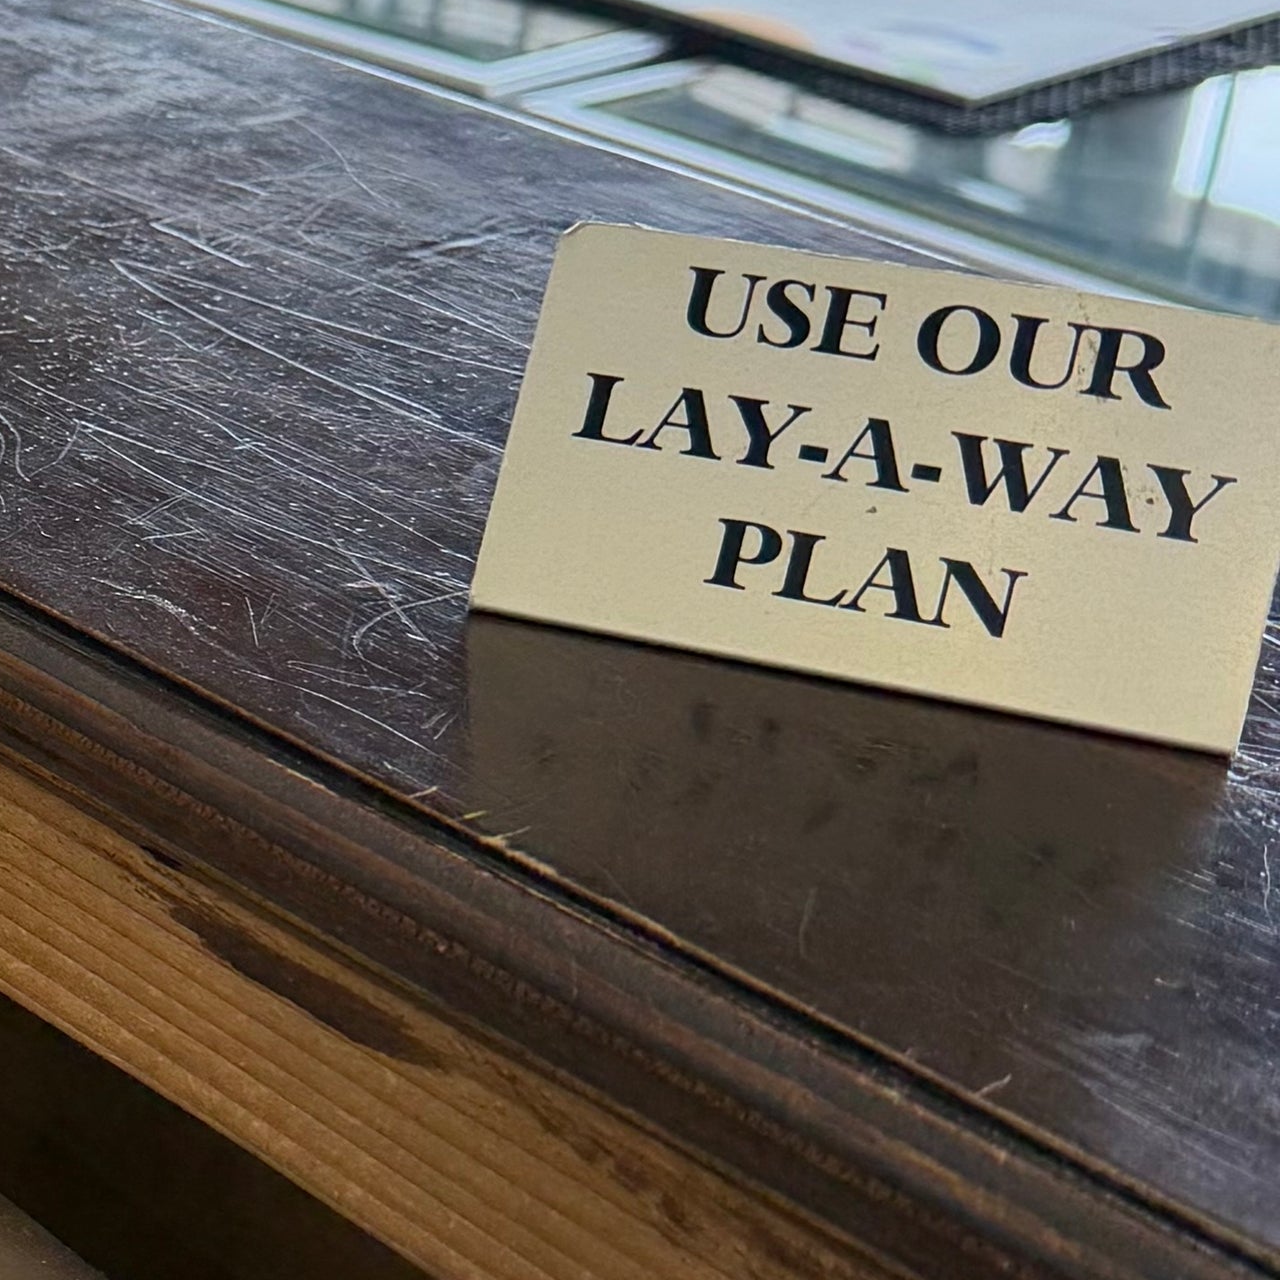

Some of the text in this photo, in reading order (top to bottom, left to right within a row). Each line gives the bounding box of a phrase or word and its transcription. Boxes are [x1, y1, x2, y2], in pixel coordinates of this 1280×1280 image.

[688, 265, 1171, 410] USE OUR
[572, 372, 1237, 544] LAY-A-WAY
[703, 517, 1028, 639] PLAN
